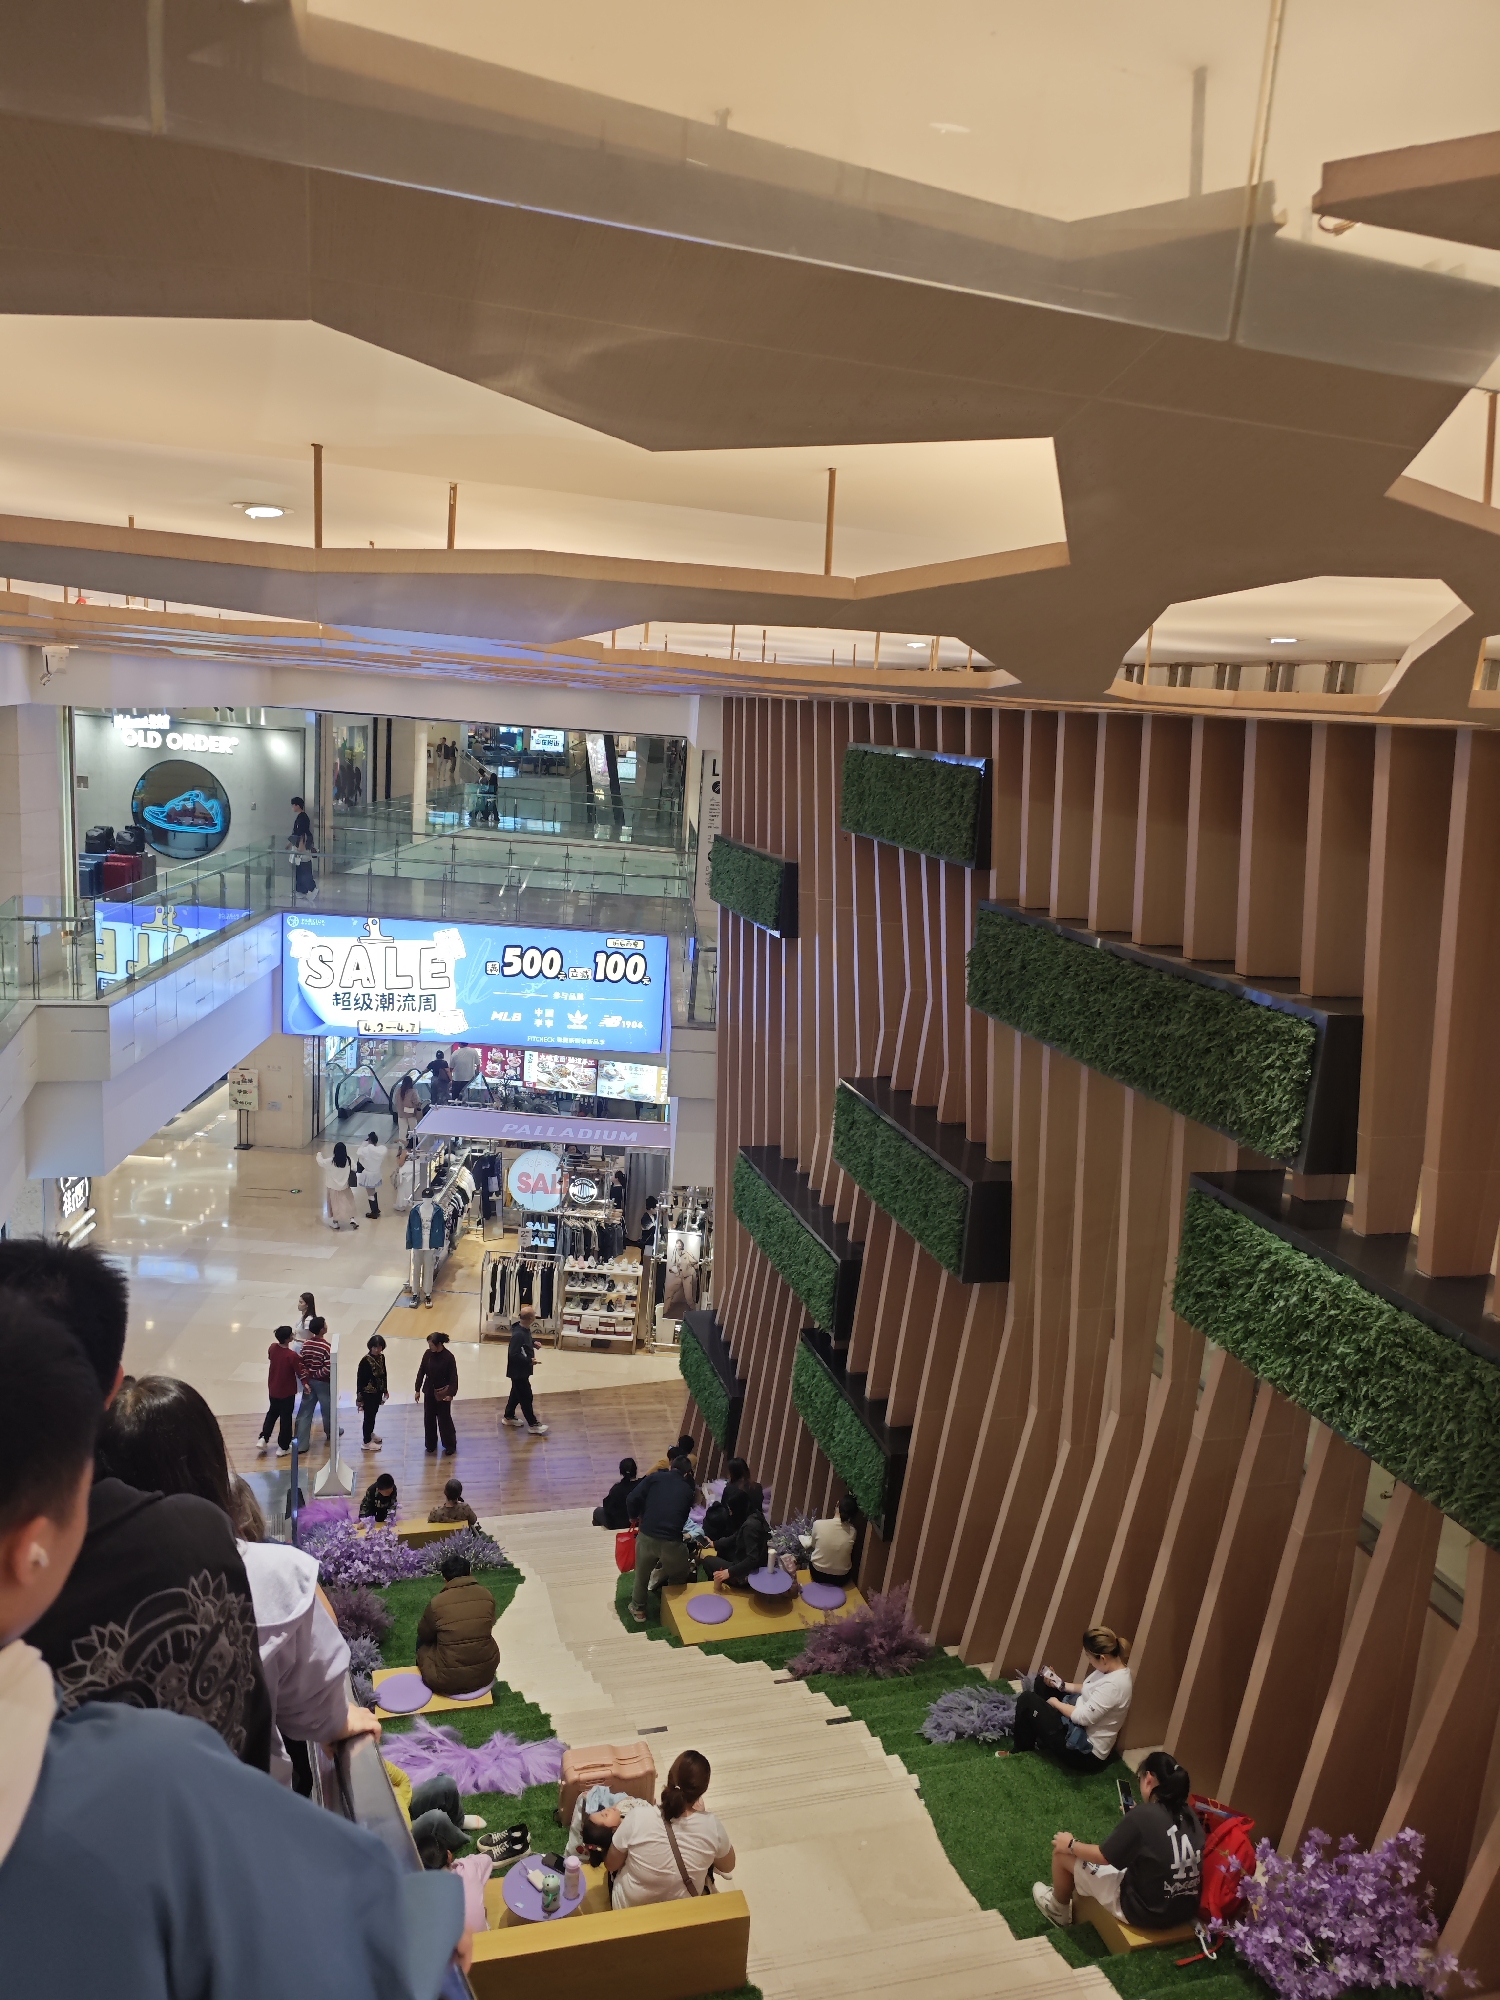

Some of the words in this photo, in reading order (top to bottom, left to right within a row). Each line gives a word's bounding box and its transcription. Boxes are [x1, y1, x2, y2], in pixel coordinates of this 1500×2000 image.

[122, 729, 162, 748] OLD
[166, 733, 235, 754] ORDER
[305, 945, 450, 990] SALE
[332, 992, 436, 1012] 超级潮流周
[491, 1011, 522, 1022] MLB
[501, 1123, 639, 1142] PALLADIUM
[526, 1222, 555, 1231] SALE
[531, 1237, 555, 1247] ALE
[1166, 1825, 1200, 1879] LA
